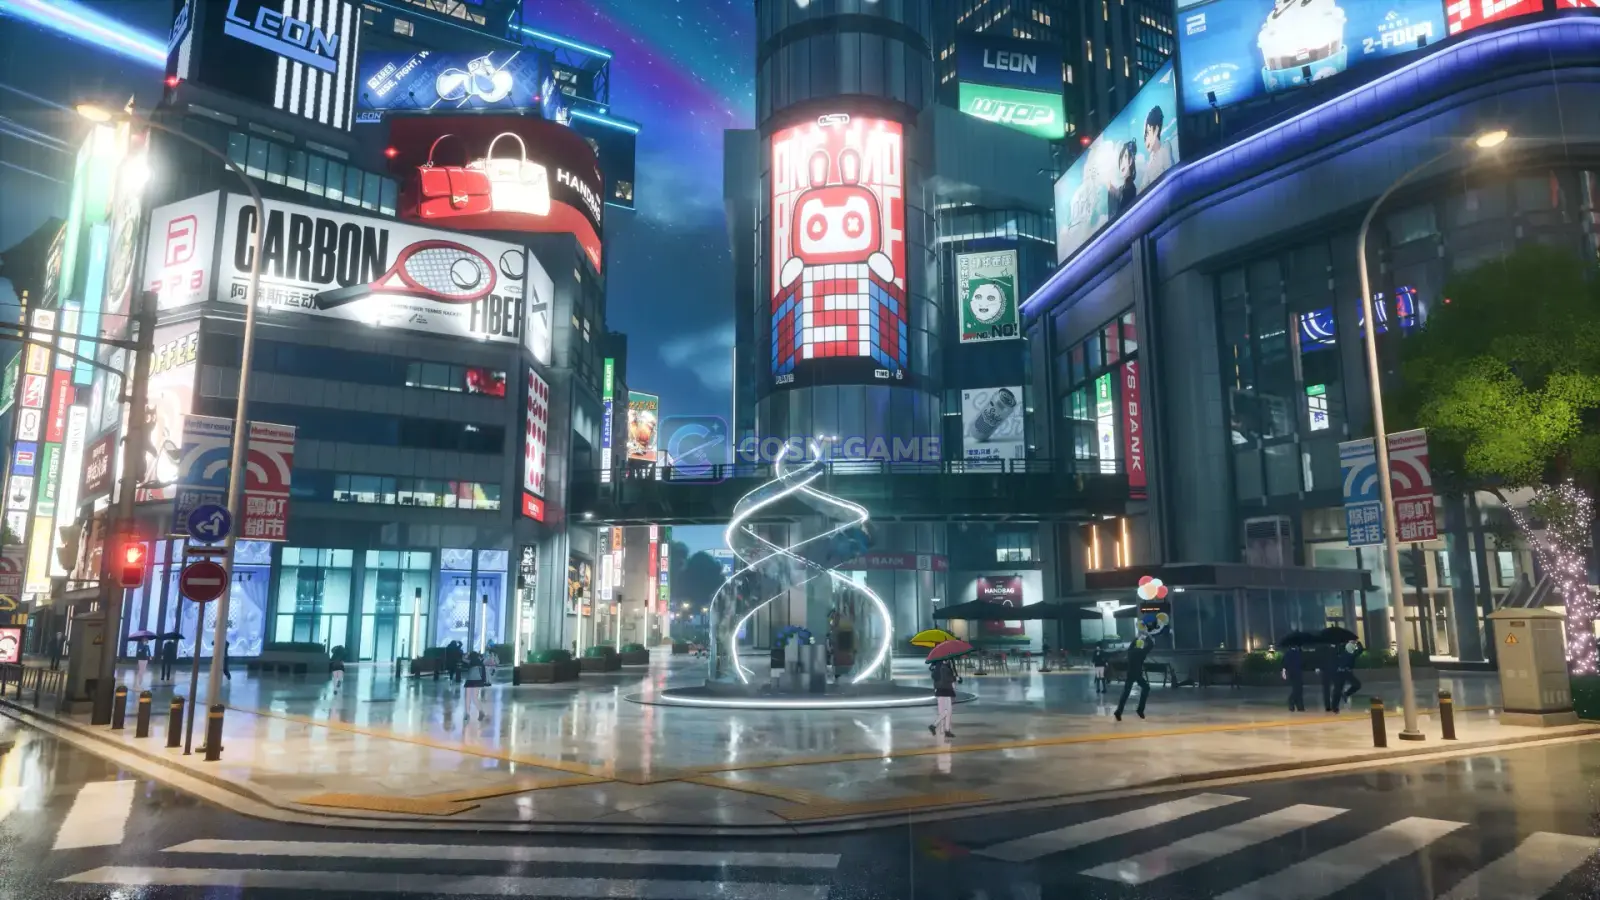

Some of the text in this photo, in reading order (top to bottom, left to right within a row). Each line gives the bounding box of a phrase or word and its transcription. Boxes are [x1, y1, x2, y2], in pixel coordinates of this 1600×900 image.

[226, 0, 339, 58] LEON
[983, 48, 1038, 75] LEON
[356, 112, 382, 120] LEON
[970, 98, 1053, 125] WITOP
[234, 204, 389, 287] CARBON
[991, 323, 1018, 338] NO!
[148, 331, 198, 377] OFFEE
[246, 497, 287, 517] 霓虹
[1348, 505, 1379, 525] 悠闲
[1398, 500, 1433, 519] 霓虹
[245, 518, 285, 536] 都市
[1350, 525, 1380, 542] 生活
[1400, 520, 1434, 539] 都市
[872, 557, 904, 565] BANK
